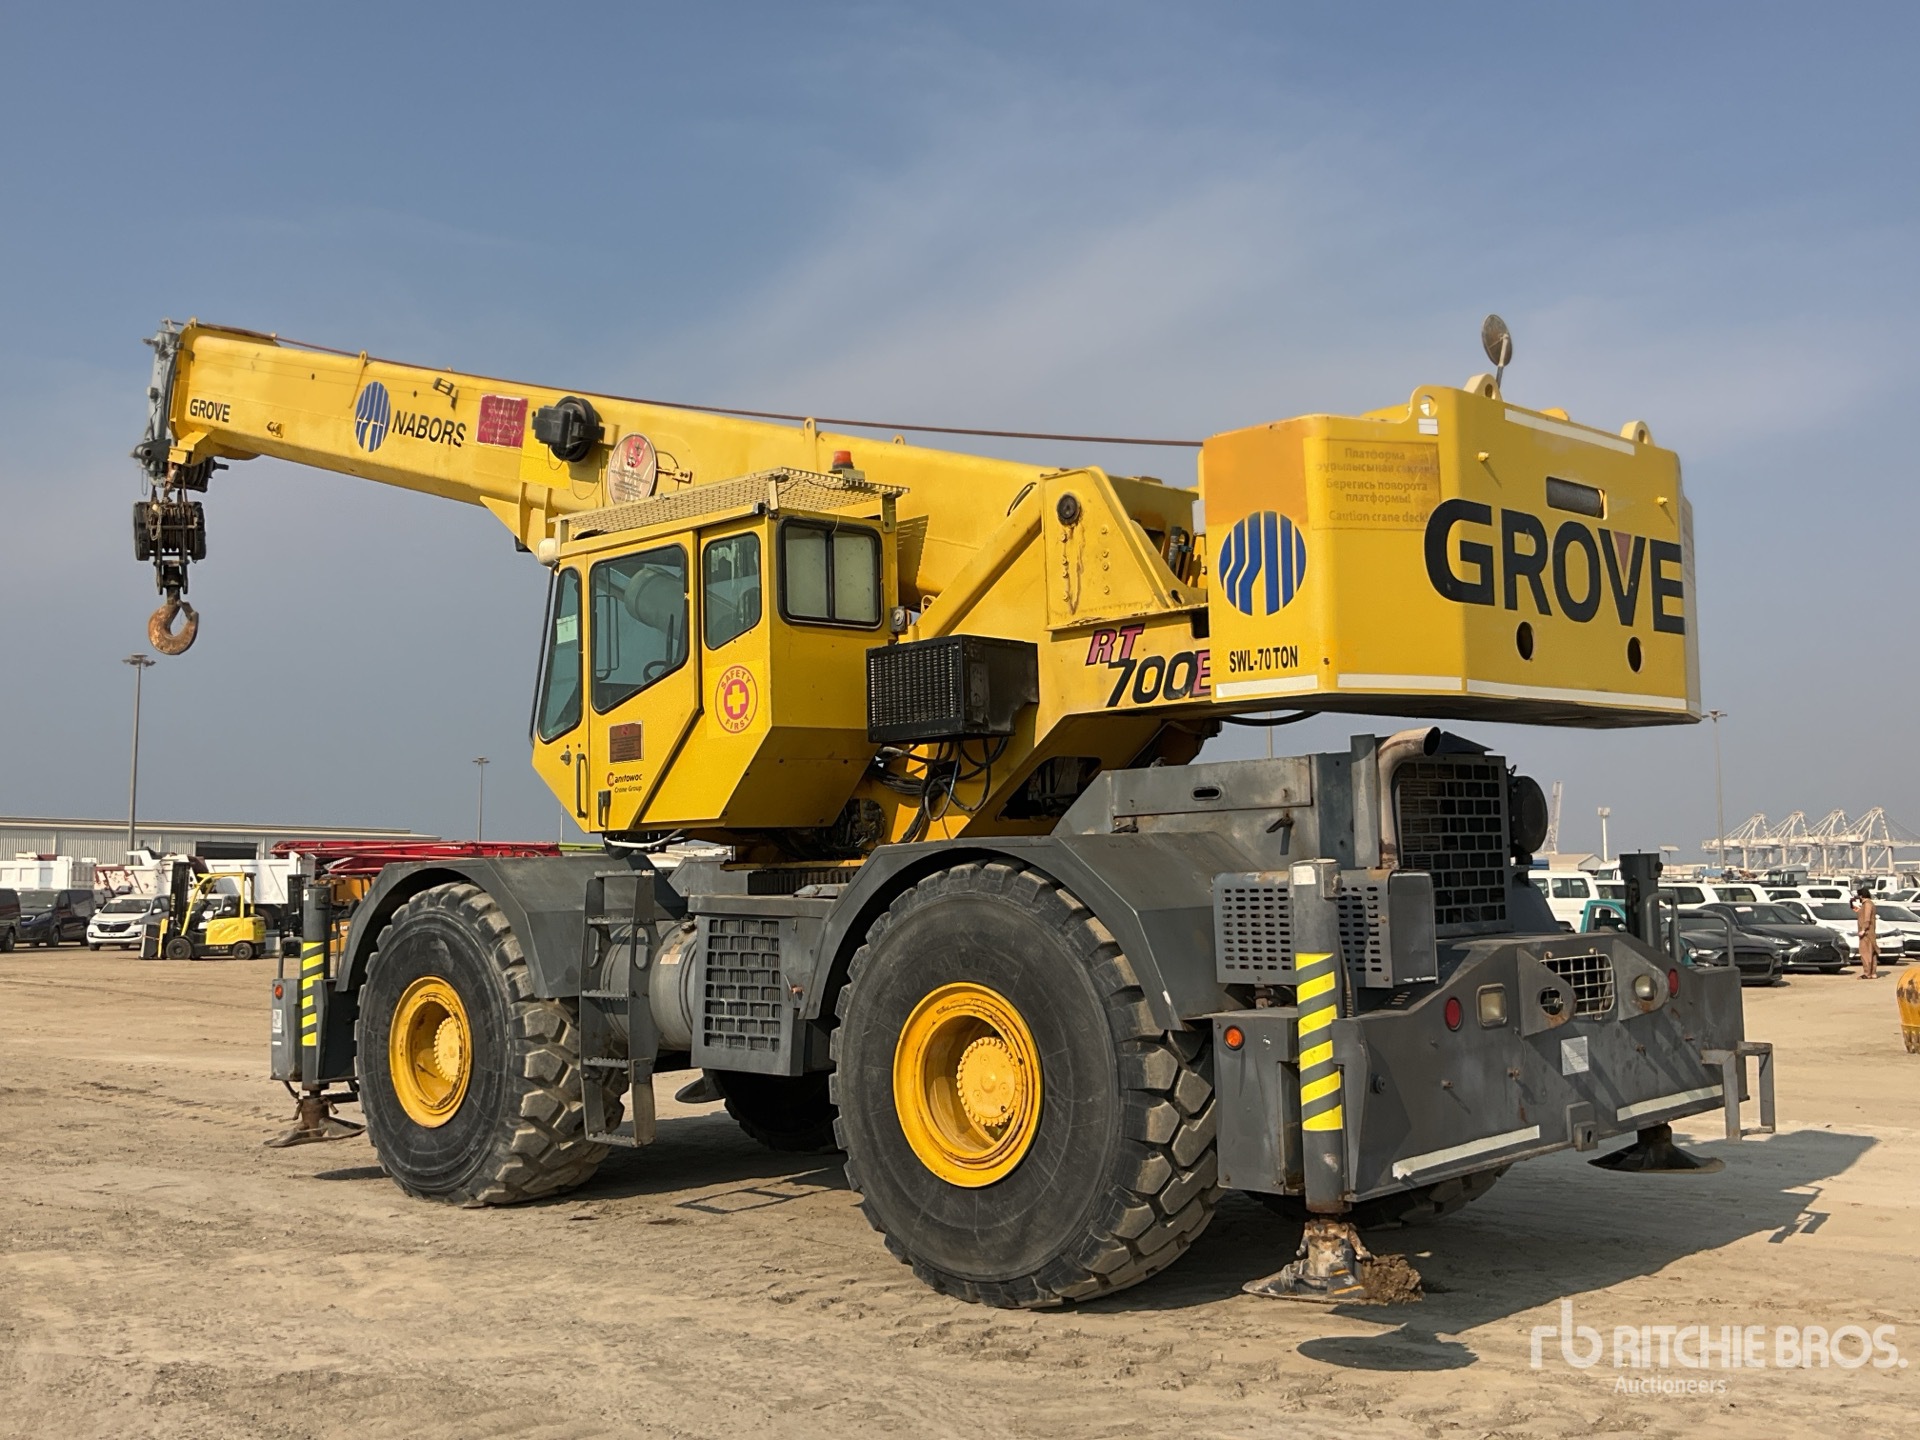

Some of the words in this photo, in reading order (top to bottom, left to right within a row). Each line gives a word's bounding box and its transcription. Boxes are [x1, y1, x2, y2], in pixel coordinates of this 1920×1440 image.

[190, 398, 231, 423] GROVE
[392, 410, 467, 448] NABORS
[1345, 447, 1406, 462] Платформа
[1327, 478, 1376, 491] Берегись
[1378, 479, 1428, 493] поворота
[1328, 510, 1370, 522] Caution
[1372, 512, 1400, 523] crane
[1424, 498, 1685, 635] GROVE
[1085, 623, 1145, 667] RT
[721, 669, 751, 690] SAFETY
[725, 713, 749, 730] FIRST
